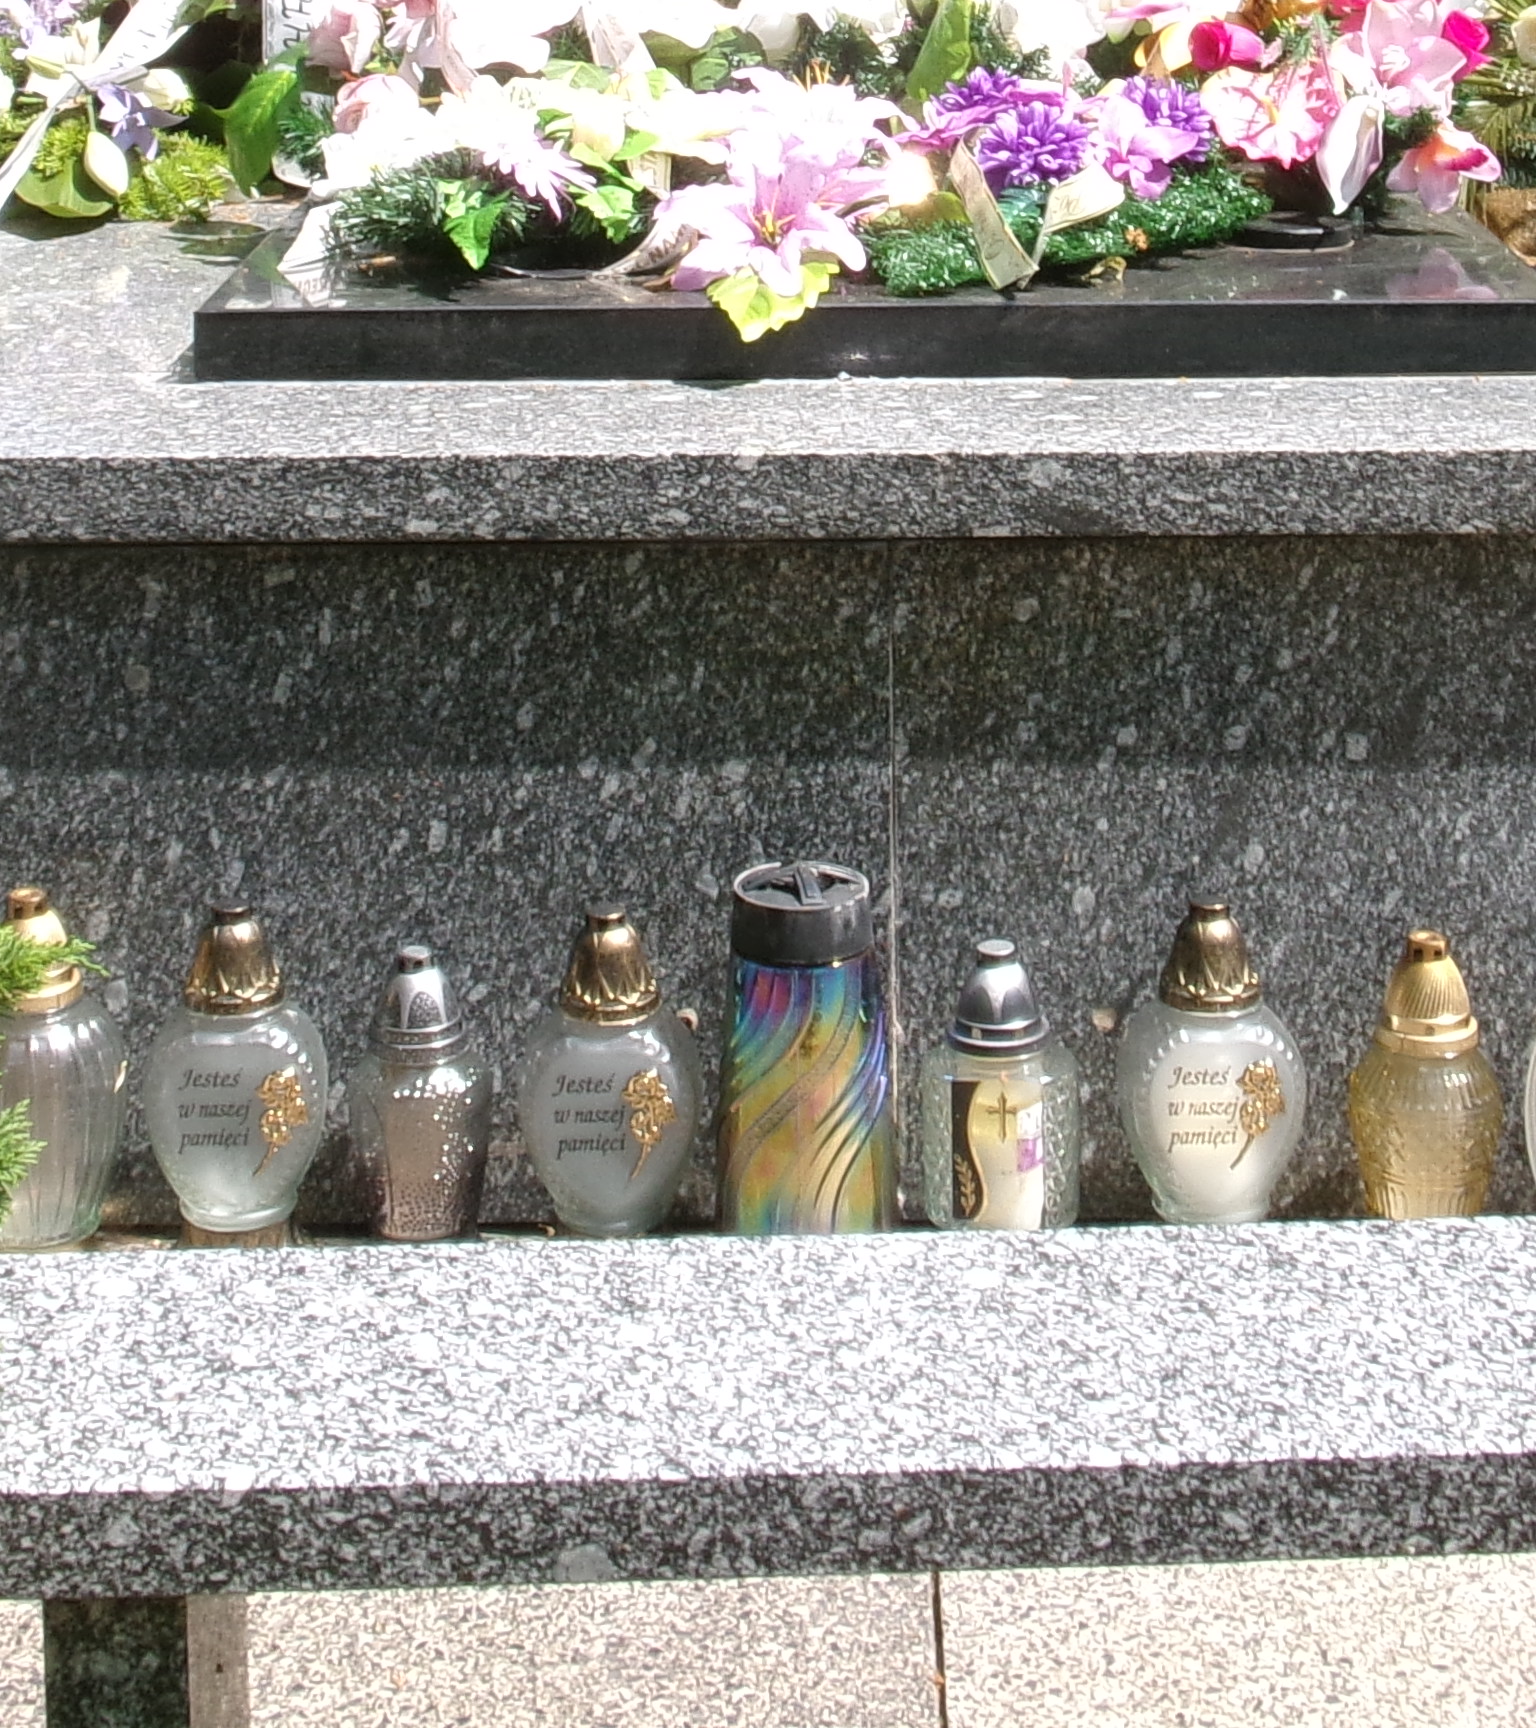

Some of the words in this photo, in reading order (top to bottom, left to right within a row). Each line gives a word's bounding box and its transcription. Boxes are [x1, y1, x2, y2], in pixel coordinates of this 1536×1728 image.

[178, 1068, 243, 1090] Jesteś
[552, 1073, 615, 1097] Jesteś
[1168, 1065, 1232, 1090] Jesteś
[178, 1103, 196, 1118] w
[199, 1100, 251, 1125] naszej
[554, 1109, 572, 1124] w
[574, 1105, 626, 1130] naszej
[1168, 1100, 1185, 1117] w
[1188, 1097, 1240, 1123] naszej
[177, 1129, 250, 1155] pamięci
[557, 1135, 626, 1160] pamięci
[1167, 1126, 1239, 1154] pamięci
